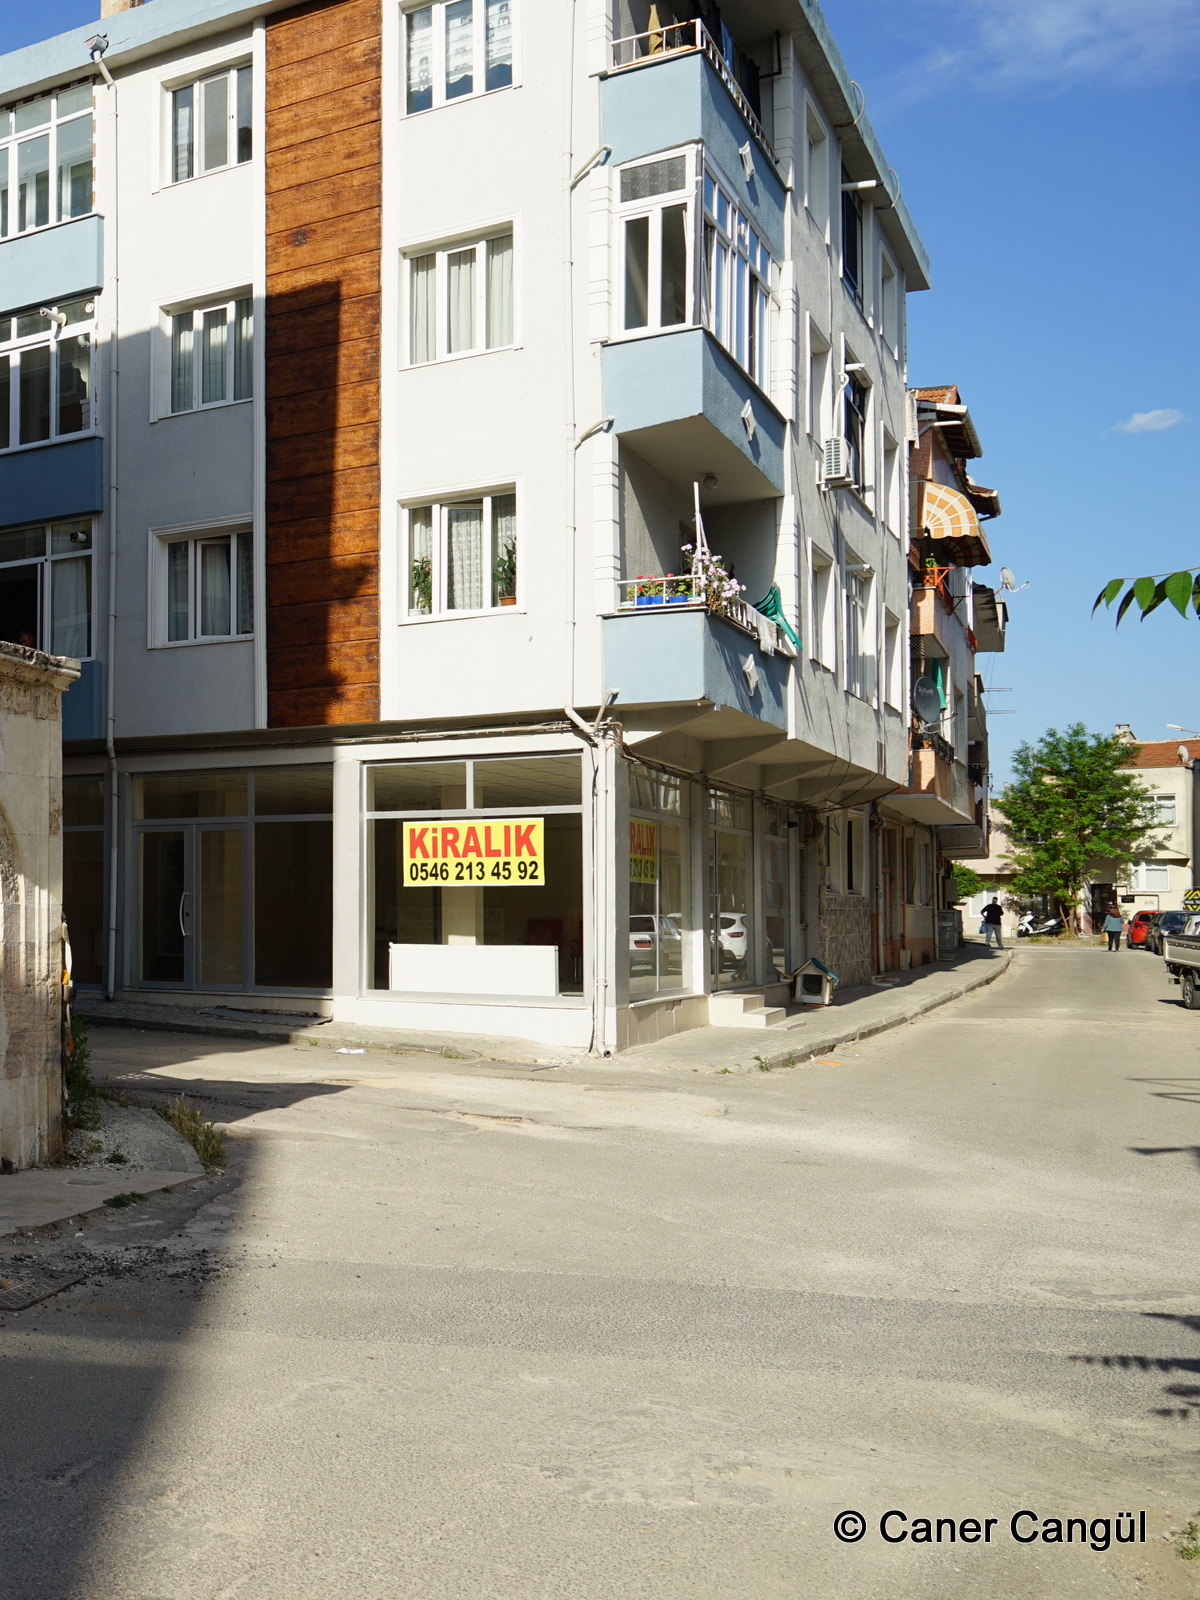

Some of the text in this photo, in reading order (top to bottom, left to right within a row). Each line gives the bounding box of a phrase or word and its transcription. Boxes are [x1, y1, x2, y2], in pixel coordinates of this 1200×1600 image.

[409, 824, 538, 859] KiRALIK
[629, 822, 655, 857] RALIK
[409, 860, 539, 881] 0546 213 45 92
